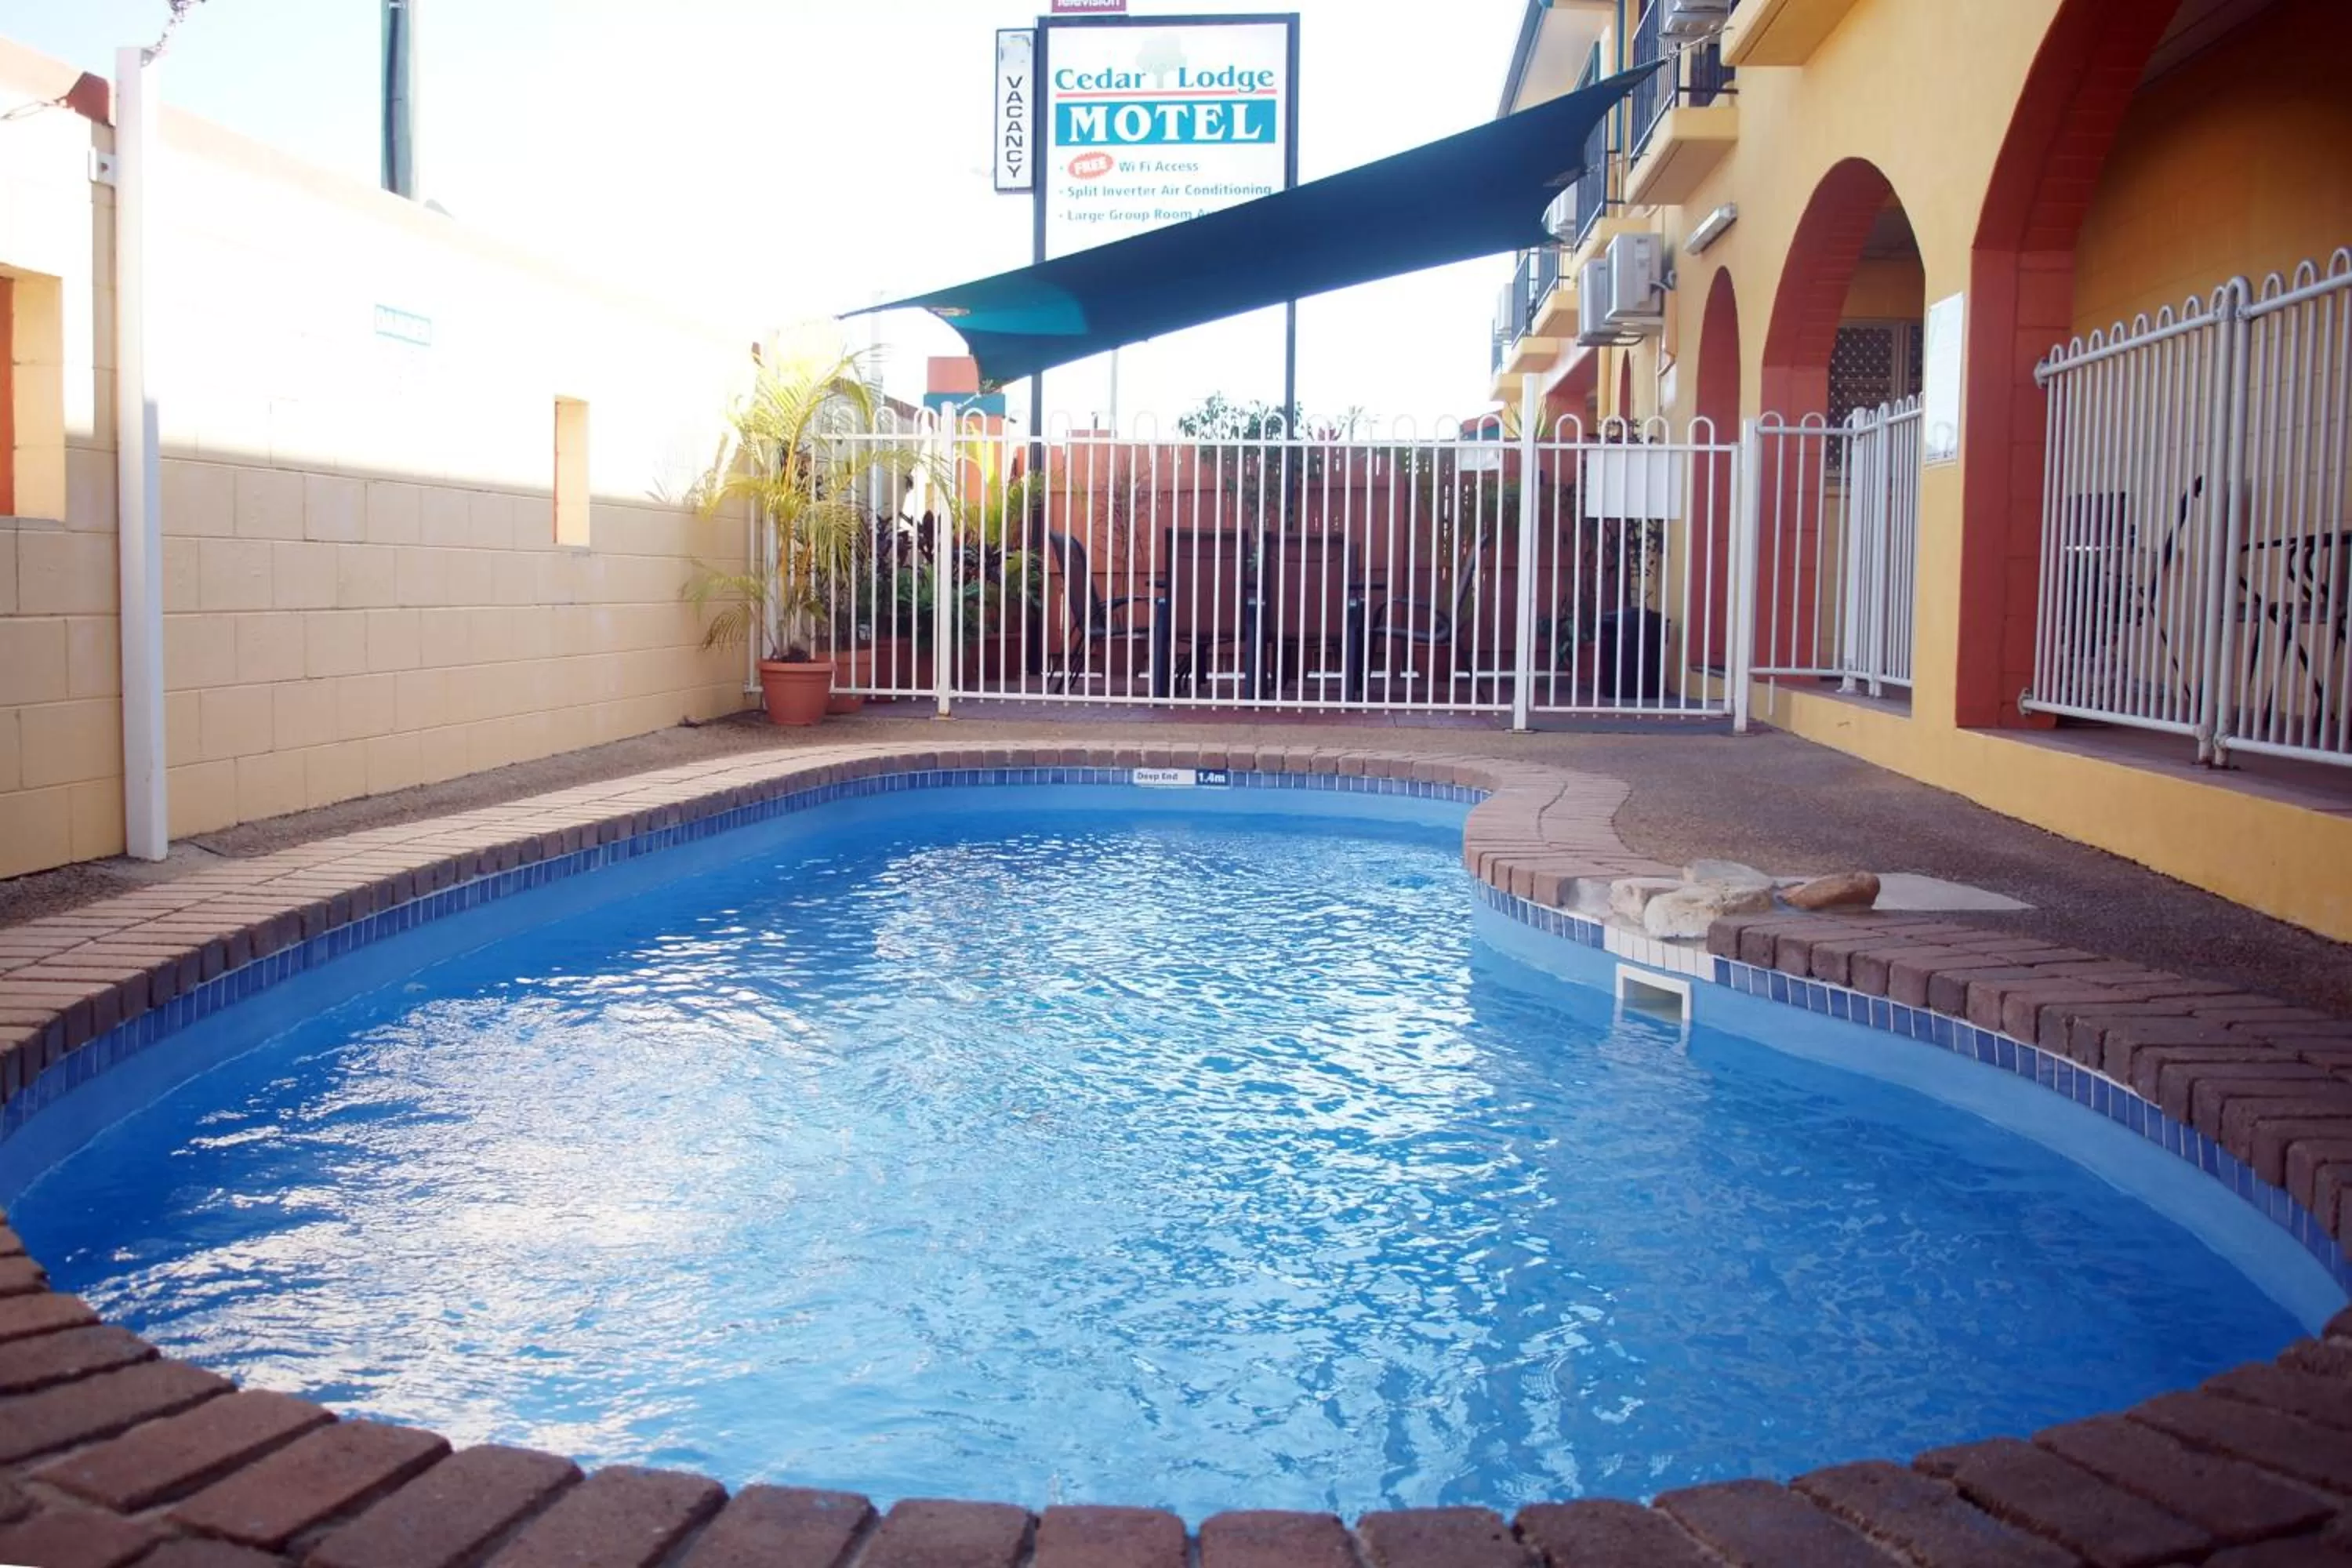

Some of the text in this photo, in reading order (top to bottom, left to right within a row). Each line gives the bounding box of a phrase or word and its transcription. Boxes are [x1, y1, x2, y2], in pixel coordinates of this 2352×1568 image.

[1055, 65, 1275, 93] Cedar Lodge
[1005, 75, 1024, 178] VACANCY
[1068, 102, 1263, 143] MOTEL
[1155, 160, 1199, 172] Access
[1067, 182, 1272, 199] Split Inverter Air Conditioning
[1067, 209, 1105, 223] Large
[1109, 209, 1150, 222] Group
[1154, 208, 1192, 220] Room
[1138, 771, 1178, 782] Deep End
[1198, 771, 1226, 783] 1.4m
